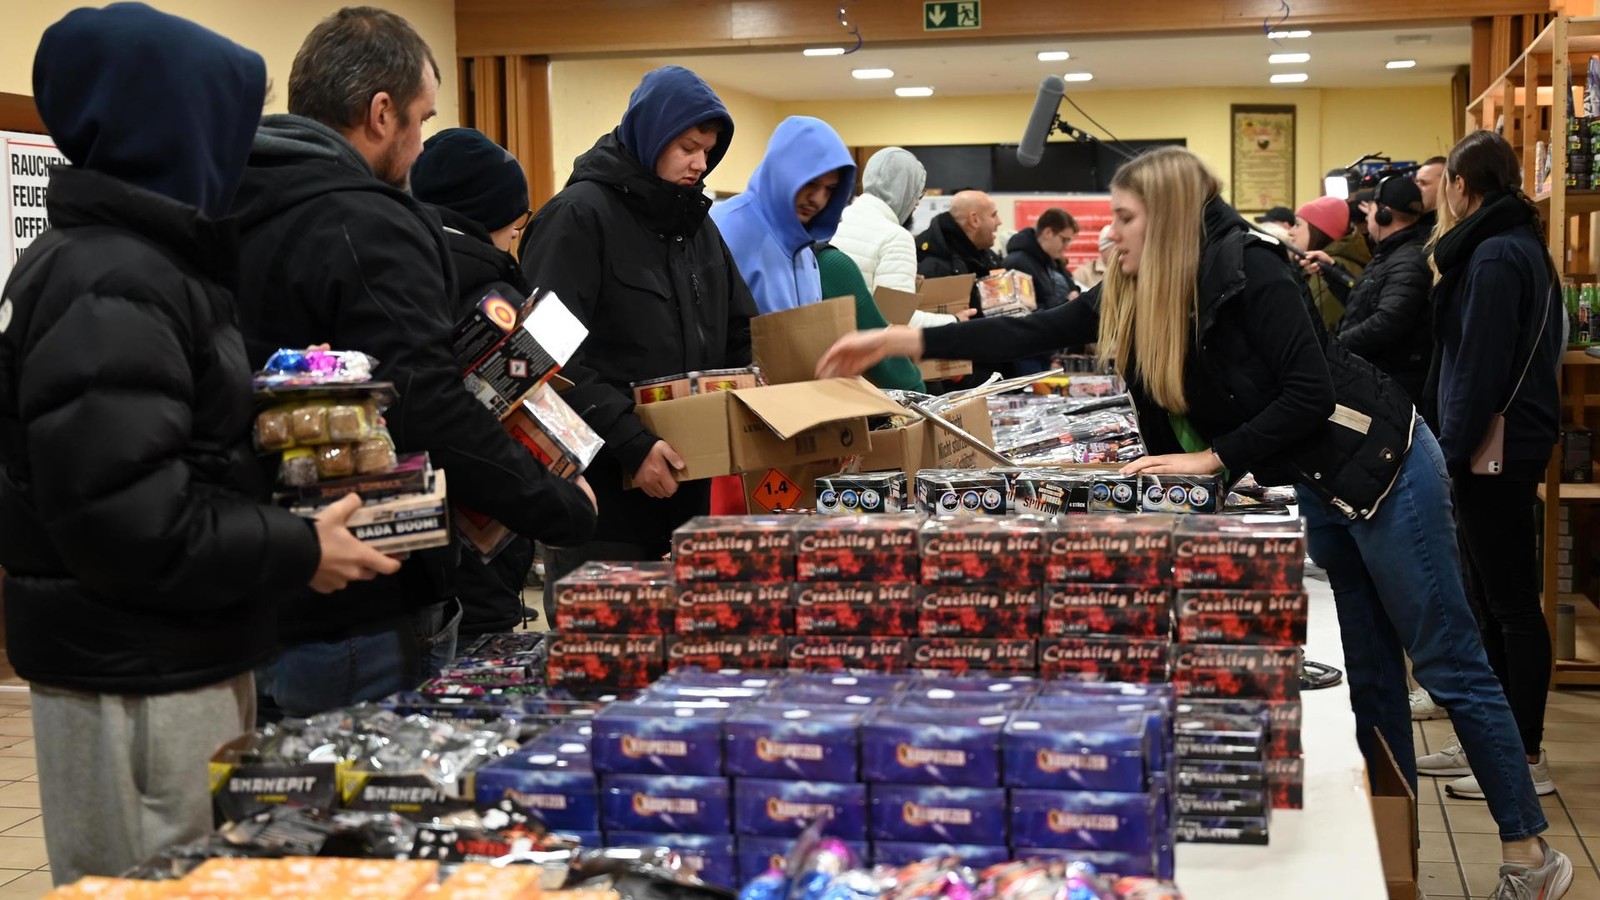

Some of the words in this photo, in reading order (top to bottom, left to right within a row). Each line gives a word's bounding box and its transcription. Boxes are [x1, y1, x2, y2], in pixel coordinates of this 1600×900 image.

[764, 480, 788, 495] 1.4
[1023, 496, 1059, 515] SPUTNIK
[355, 520, 393, 540] BADA
[395, 517, 438, 534] BOOM!
[1272, 706, 1298, 721] ird
